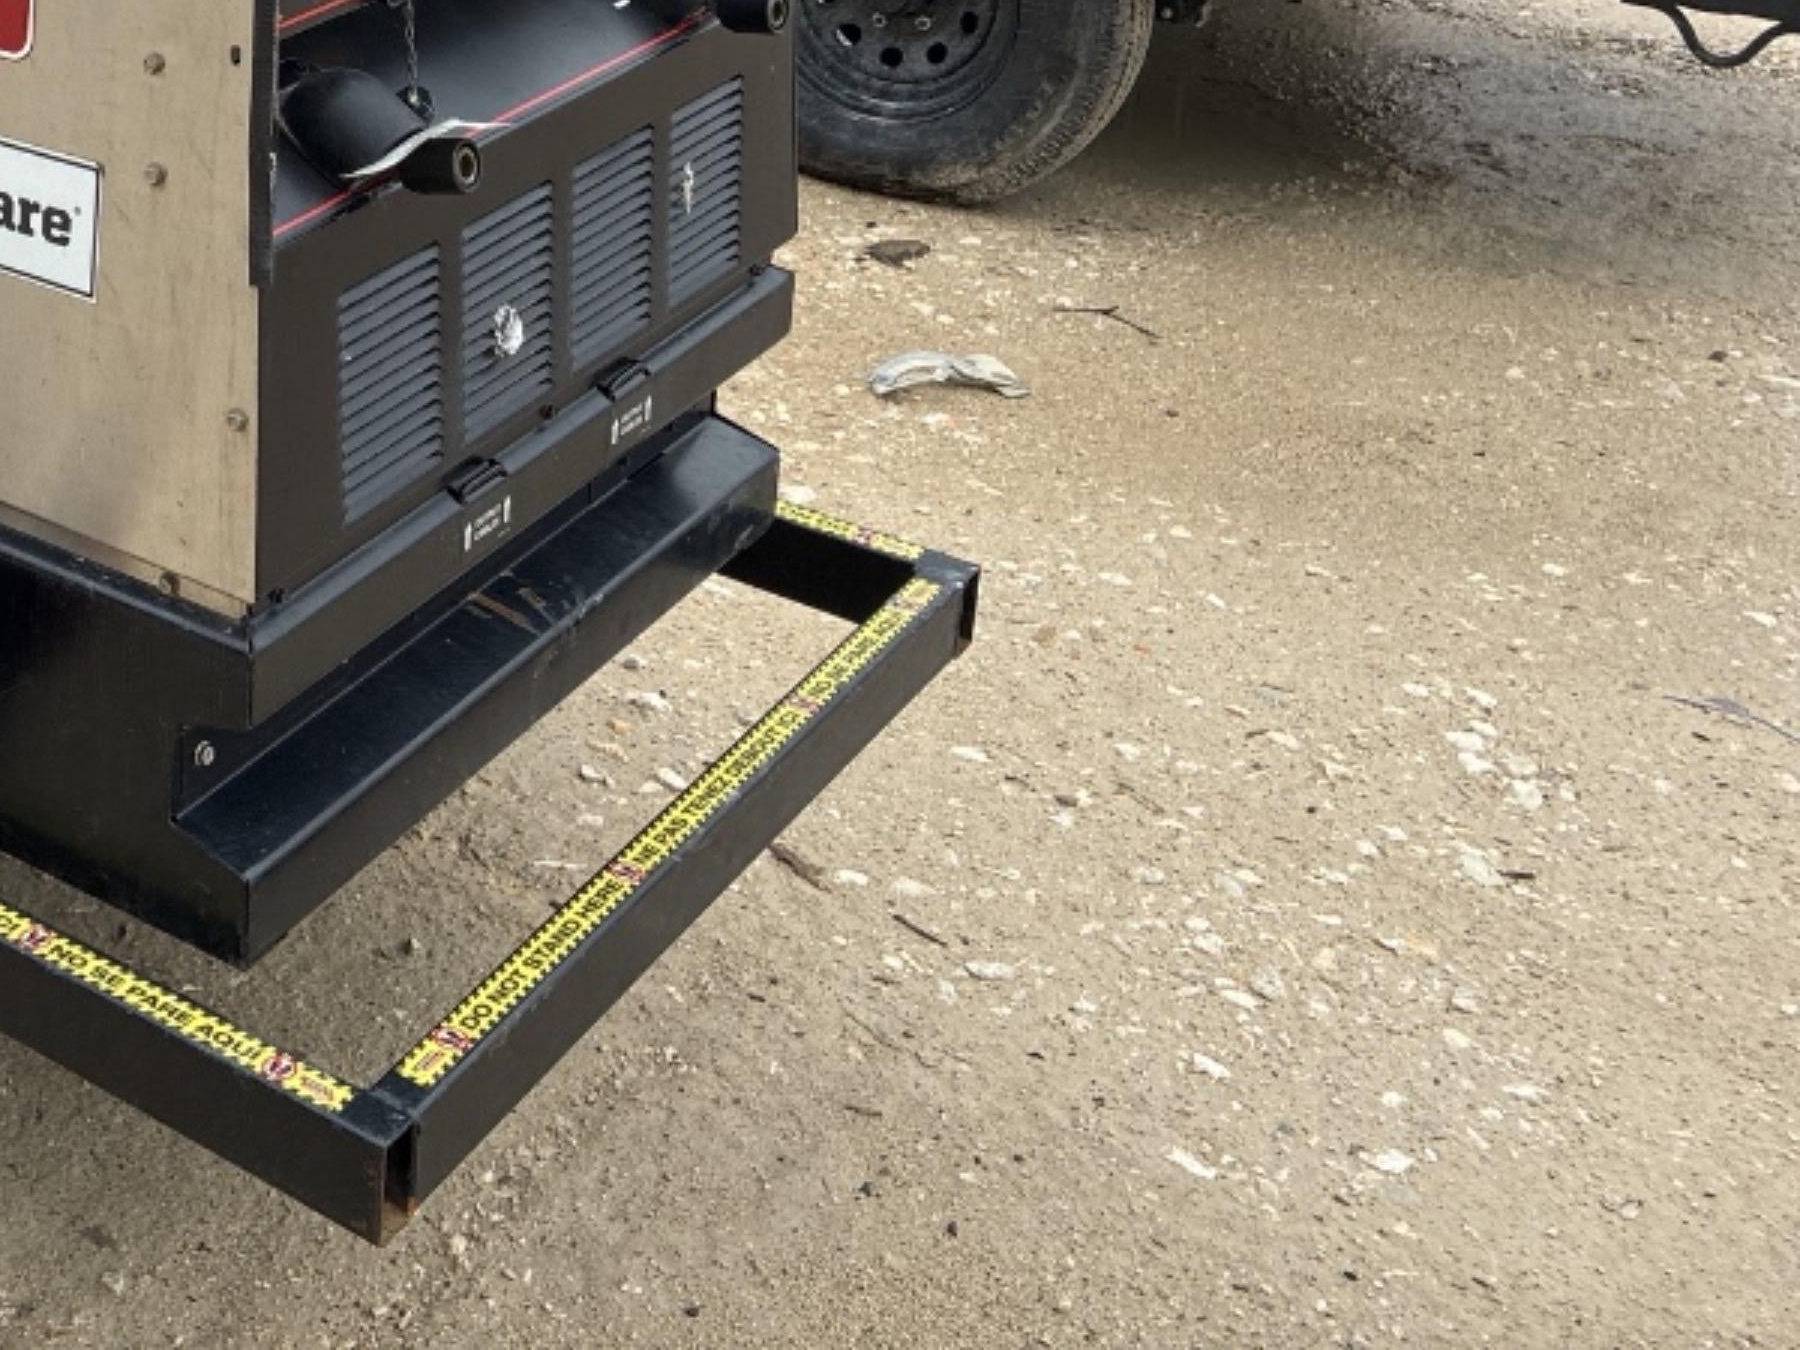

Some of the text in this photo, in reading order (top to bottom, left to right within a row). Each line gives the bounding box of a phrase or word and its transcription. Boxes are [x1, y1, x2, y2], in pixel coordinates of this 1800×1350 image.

[48, 942, 87, 970] NO
[195, 1019, 262, 1060] AQUI
[458, 879, 623, 1031] DO NOT STAND HERE
